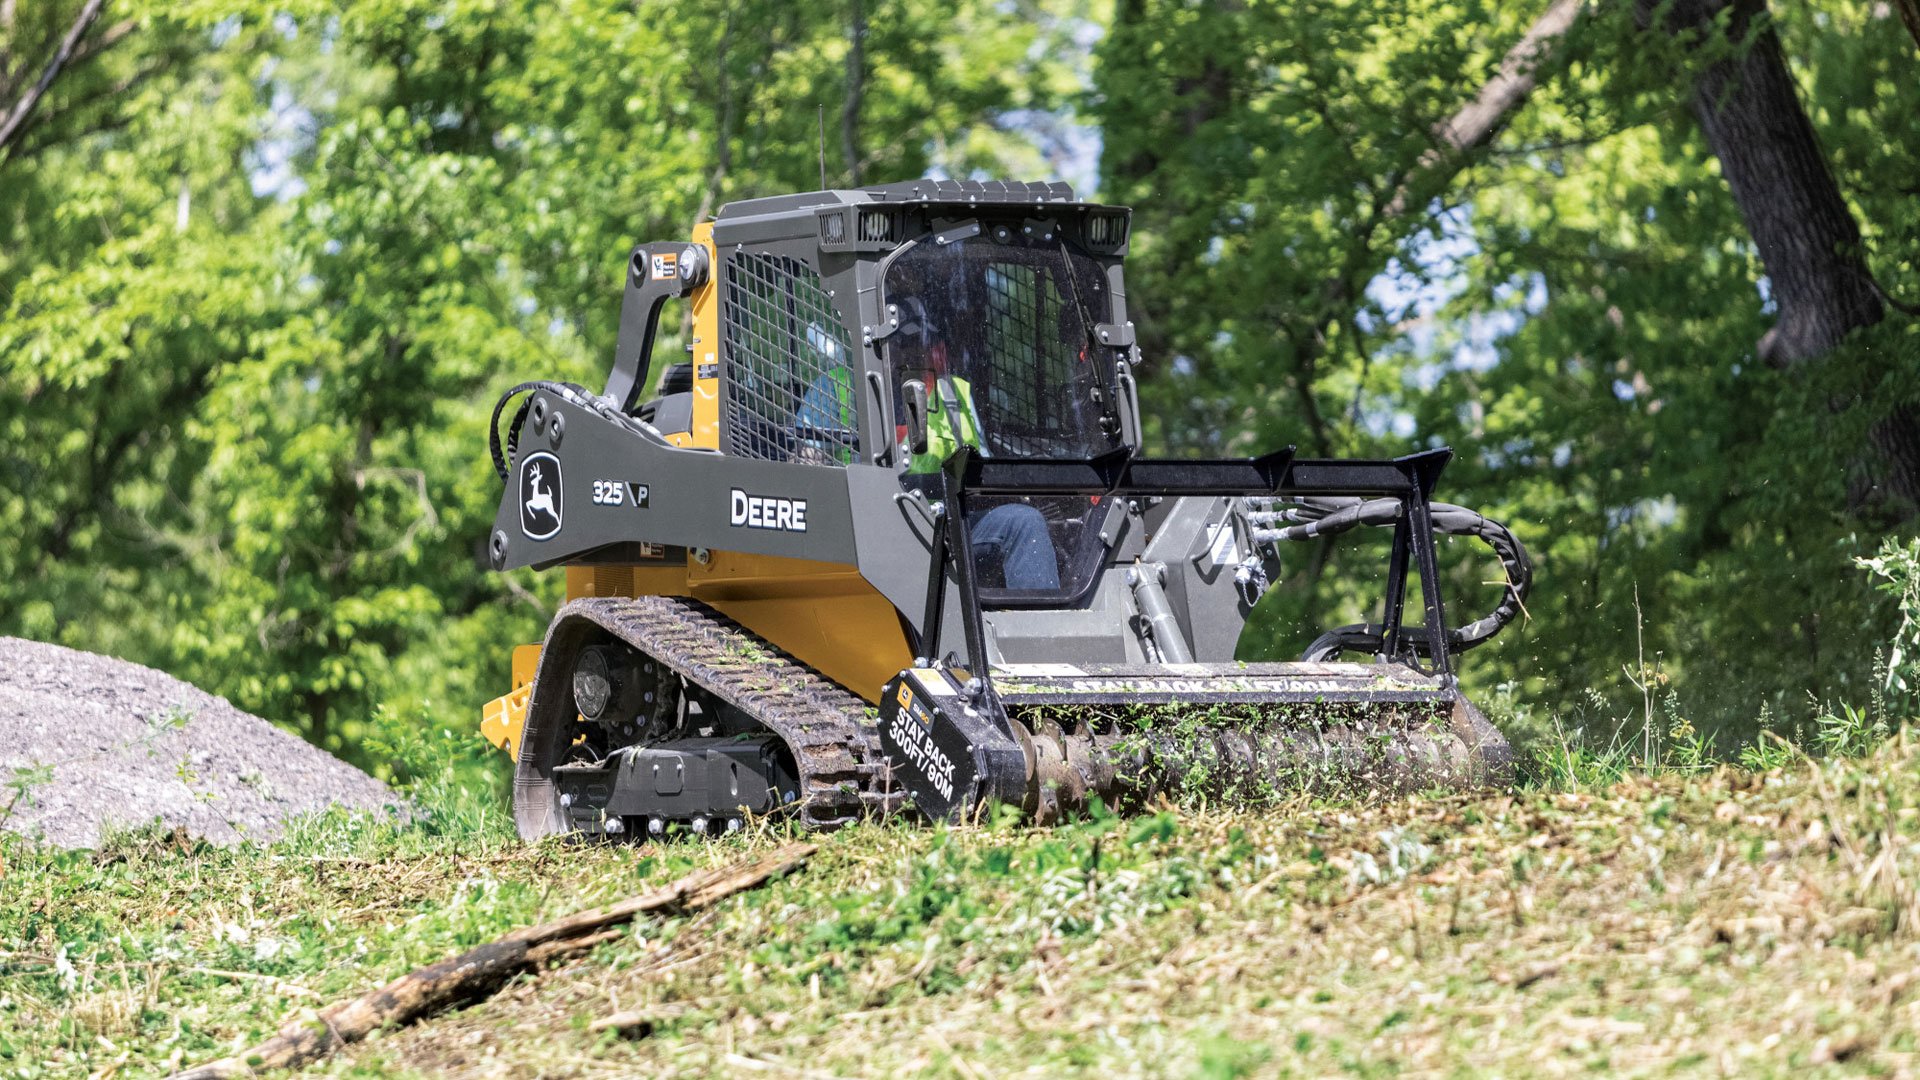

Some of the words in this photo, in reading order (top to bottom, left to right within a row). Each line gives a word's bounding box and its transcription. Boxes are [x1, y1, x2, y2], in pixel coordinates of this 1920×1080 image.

[593, 481, 624, 506] 325
[637, 486, 649, 505] P
[730, 489, 807, 531] DEERE
[1209, 679, 1339, 692] 3FT/90M
[896, 707, 926, 744] STAY
[924, 736, 956, 782] BACK
